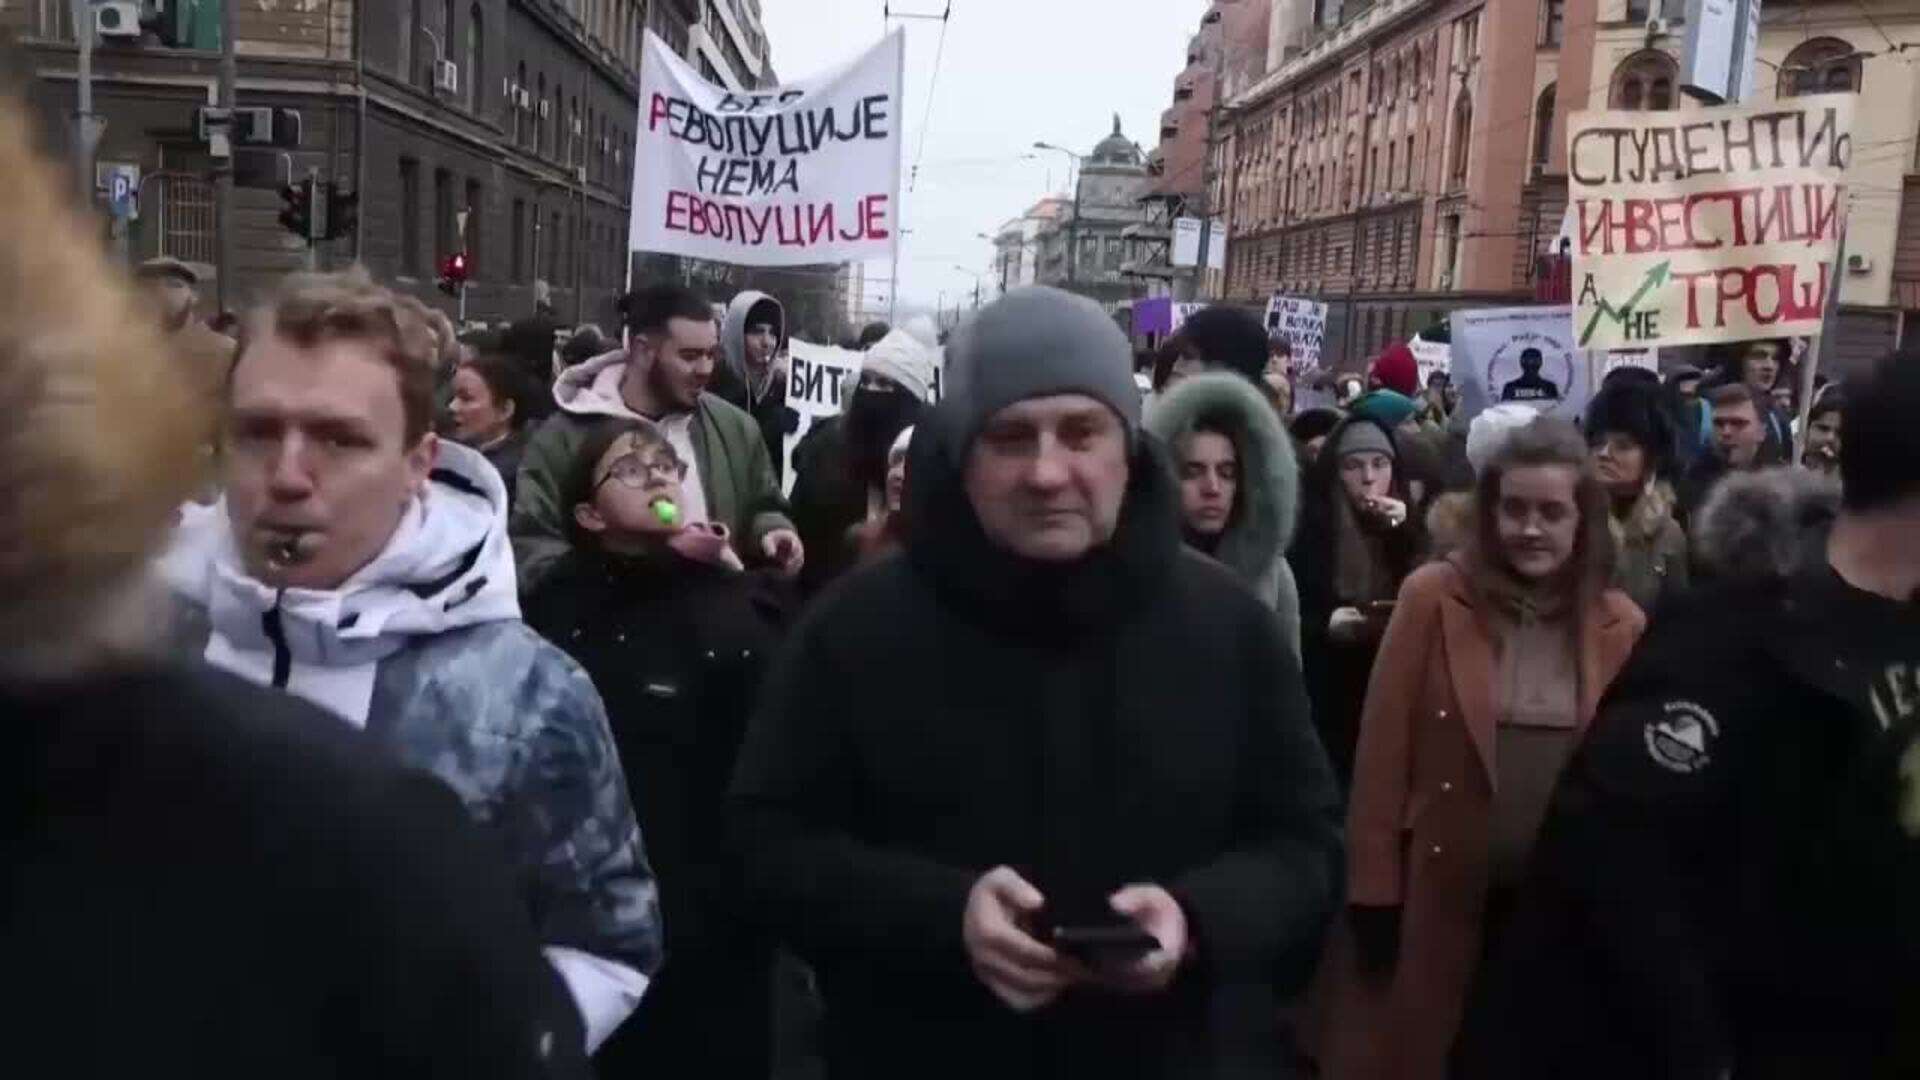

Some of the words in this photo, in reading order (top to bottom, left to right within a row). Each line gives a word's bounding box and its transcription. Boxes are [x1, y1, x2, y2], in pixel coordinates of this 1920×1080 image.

[650, 93, 888, 156] РЕВОЛУЦИЈЕ
[697, 156, 799, 196] НЕМА
[665, 190, 889, 247] ЕВОЛУЦИЈЕ
[1578, 272, 1600, 306] А
[1621, 309, 1661, 341] НЕ
